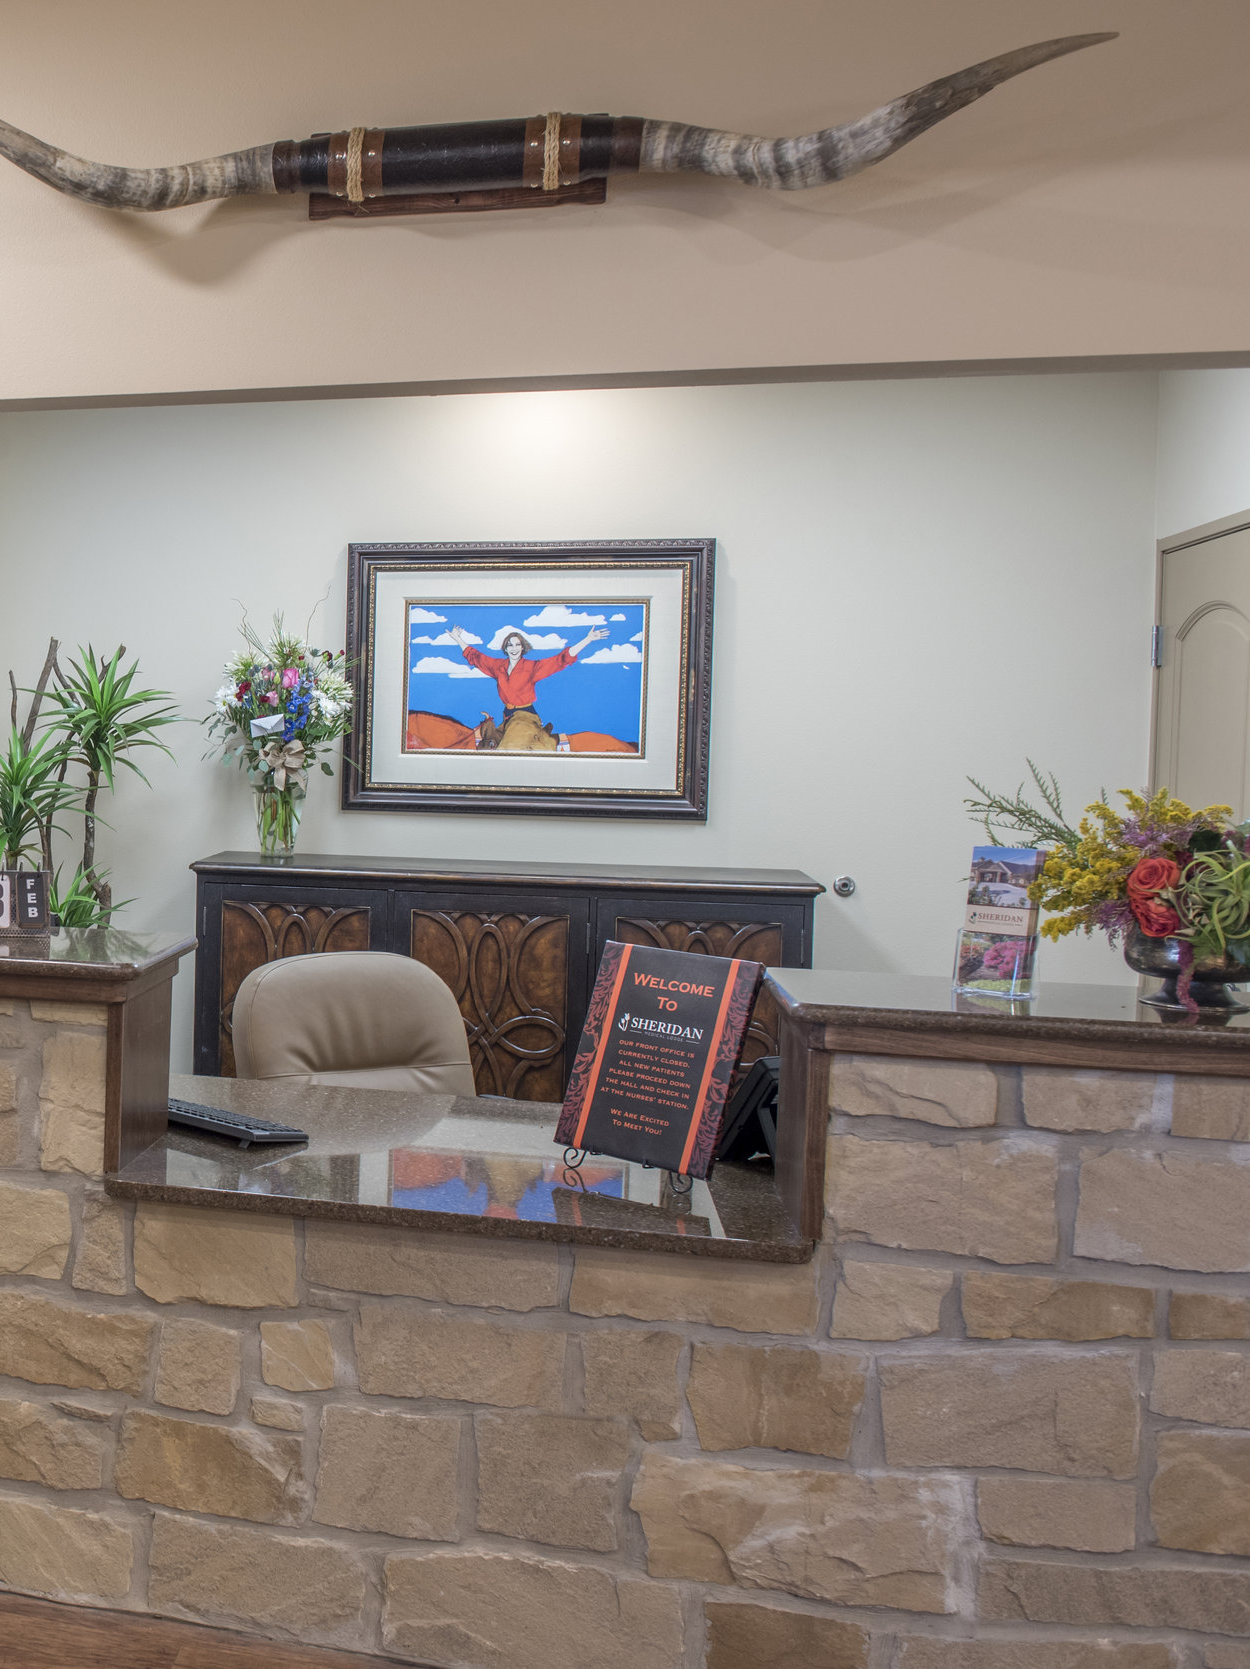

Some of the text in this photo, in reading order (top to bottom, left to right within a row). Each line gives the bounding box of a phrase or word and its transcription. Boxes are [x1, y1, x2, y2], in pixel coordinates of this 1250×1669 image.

[26, 878, 39, 918] FEB
[977, 912, 1024, 923] SHERIDAN
[634, 972, 715, 998] WELCOME
[657, 996, 678, 1012] TO
[630, 1017, 704, 1040] SHERIDAN
[644, 1031, 665, 1039] MEDICAL
[619, 1039, 634, 1047] OUR
[635, 1042, 659, 1052] FRONT
[660, 1047, 686, 1057] OFFICE
[618, 1049, 690, 1069] CURRENTLY CLOSED.
[608, 1068, 691, 1089] PLEASE PROCEED DOWN
[634, 1063, 650, 1071] NEW
[651, 1066, 685, 1078] PATIENTS
[606, 1077, 619, 1085] THE
[620, 1080, 638, 1089] HALL
[640, 1084, 655, 1092] AND
[656, 1088, 680, 1098] CHECK
[611, 1088, 624, 1096] THE
[657, 1099, 689, 1110] STATION.
[610, 1108, 670, 1127] WE ARE EXCITED
[623, 1121, 643, 1131] MEET
[645, 1126, 662, 1136] YOU!
